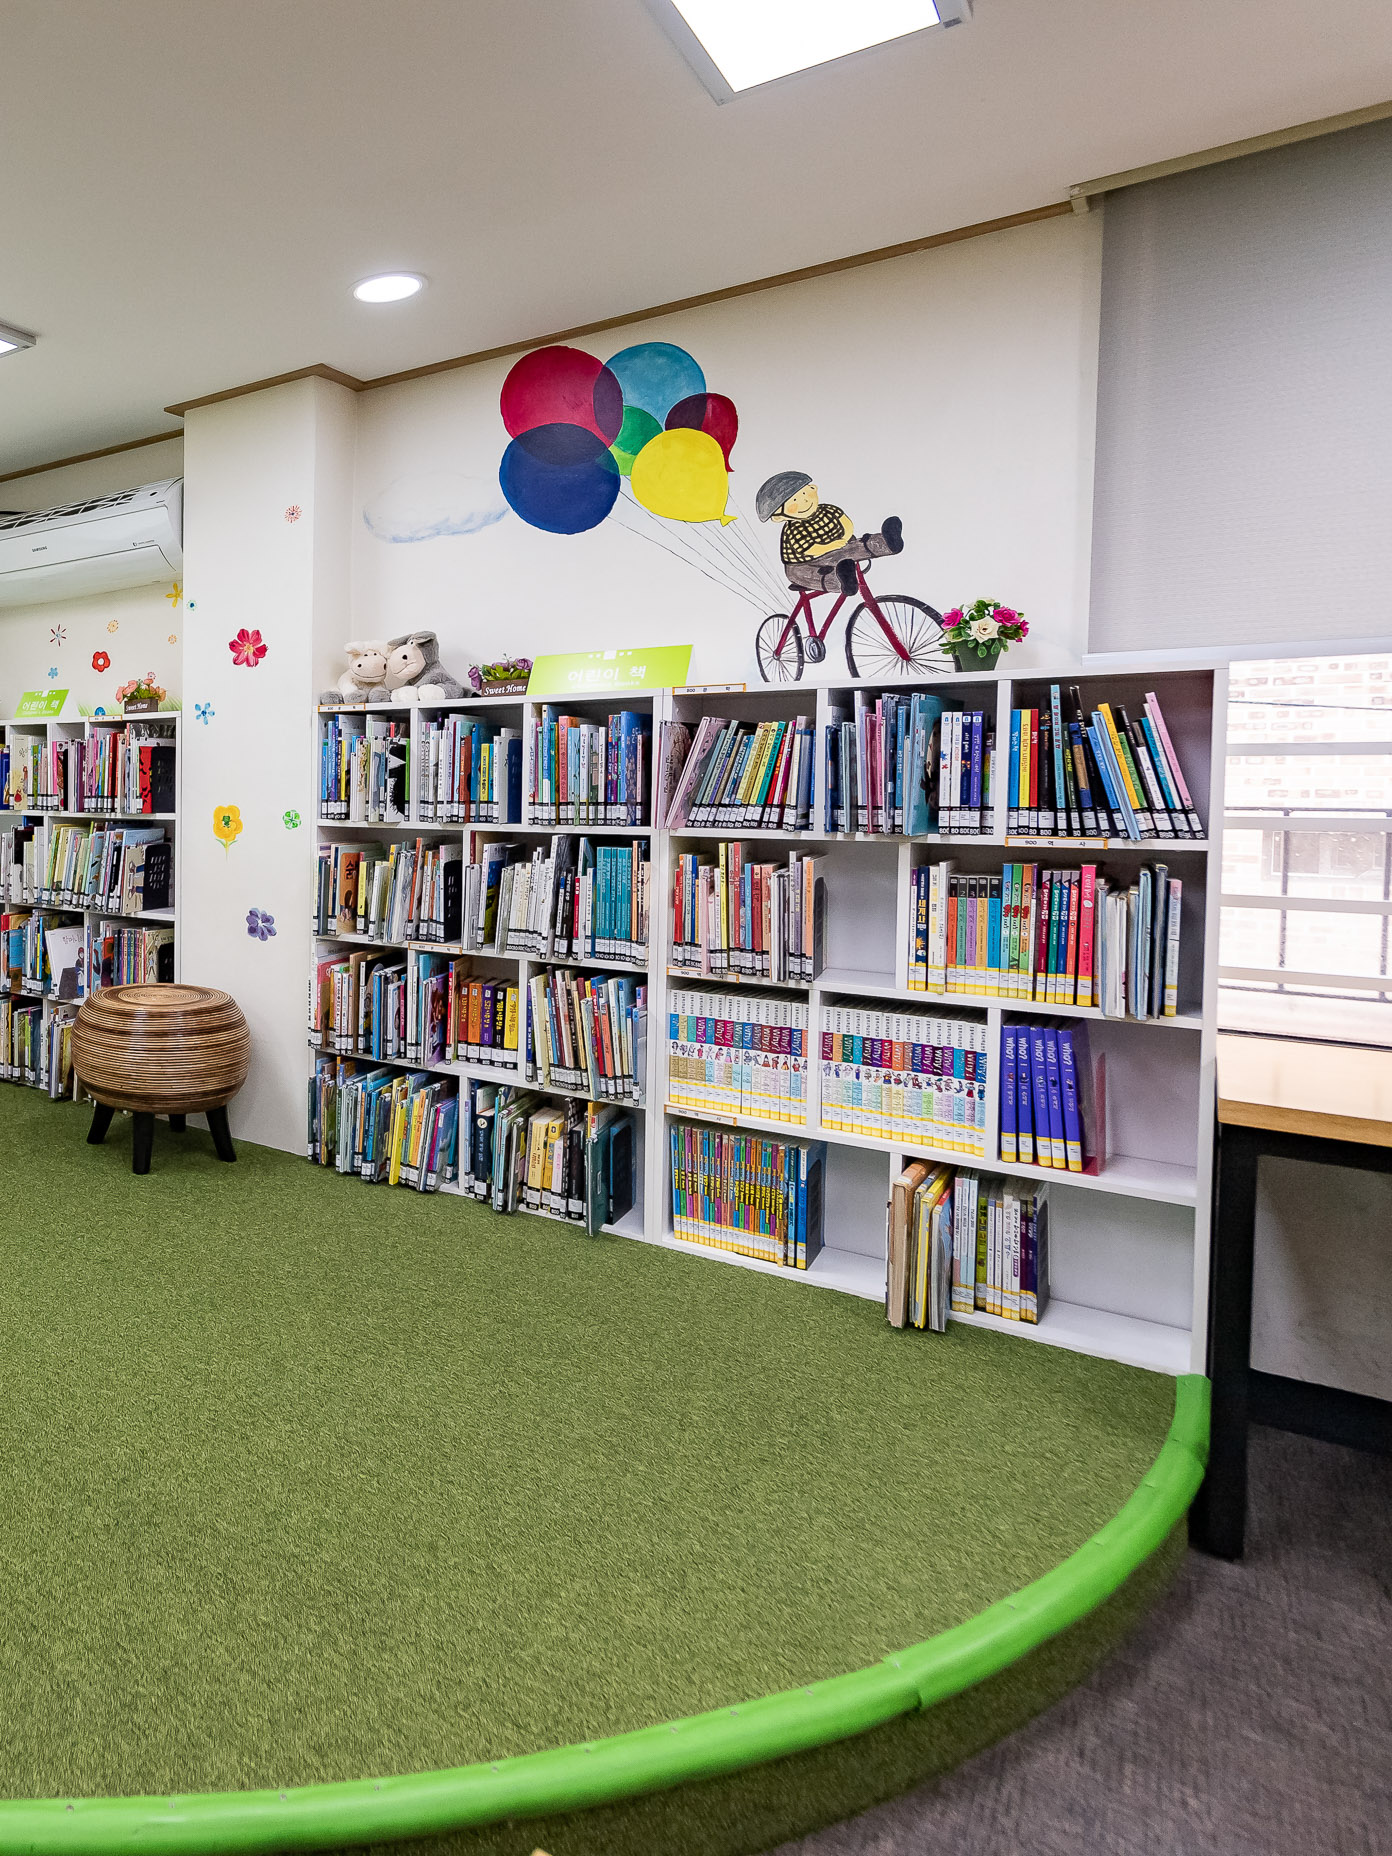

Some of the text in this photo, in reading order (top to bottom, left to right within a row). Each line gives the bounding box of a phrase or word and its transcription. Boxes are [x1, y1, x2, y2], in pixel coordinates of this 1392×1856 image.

[568, 665, 646, 683] 어린이 책
[484, 684, 526, 696] Sweet Home
[22, 699, 60, 711] 어린이 책
[697, 1018, 706, 1042] Why?
[716, 1021, 725, 1044] Why?
[725, 1022, 734, 1047] Why?
[735, 1024, 743, 1048] Why?
[743, 1025, 752, 1049] Why?
[762, 1027, 771, 1052] Why?
[772, 1028, 781, 1052] Why?
[781, 1029, 791, 1053] Why?
[792, 1031, 802, 1055] Why?
[823, 1034, 833, 1060] Why?
[844, 1036, 853, 1061] Why?
[863, 1039, 872, 1065] Why?
[872, 1040, 882, 1066] Why?
[882, 1040, 892, 1066] Why?
[912, 1044, 922, 1069] Why?
[923, 1046, 933, 1072] Why?
[933, 1047, 943, 1074] Why?
[943, 1047, 954, 1075] Why?
[965, 1051, 976, 1079] Why?
[976, 1054, 987, 1081] Why?
